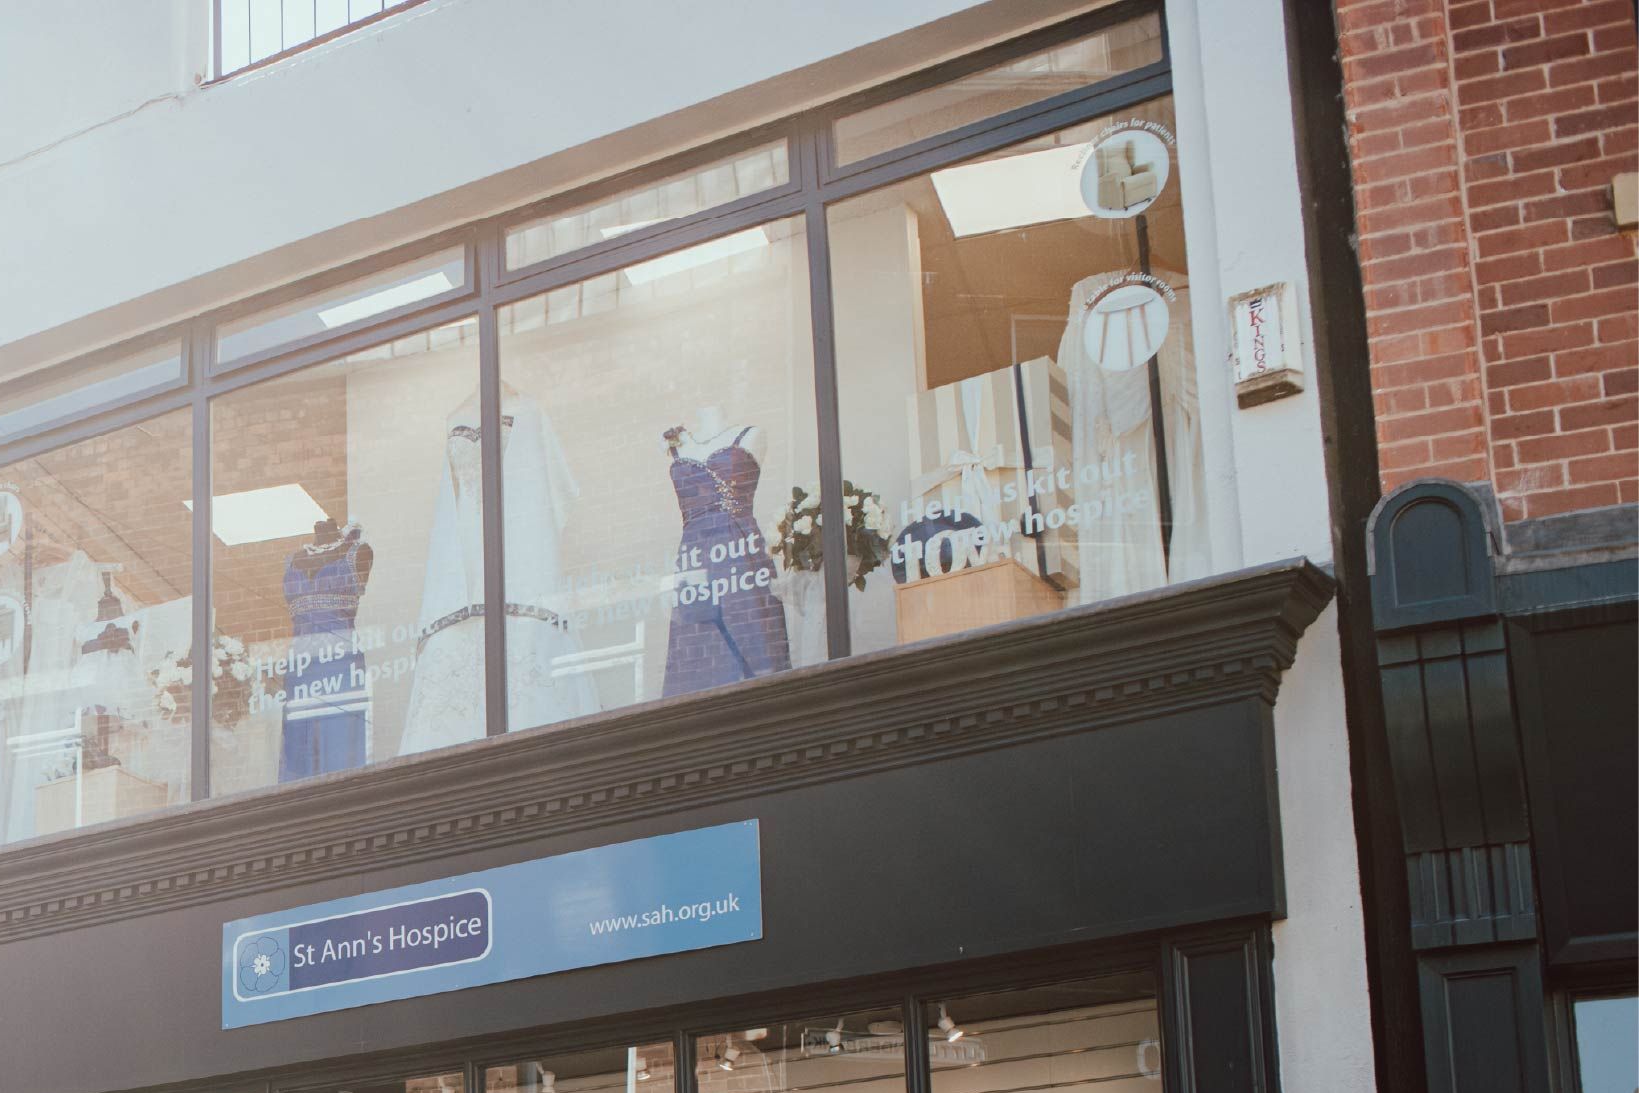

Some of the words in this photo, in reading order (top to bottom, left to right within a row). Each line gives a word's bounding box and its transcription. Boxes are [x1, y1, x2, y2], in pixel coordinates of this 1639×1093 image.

[1130, 117, 1145, 128] for
[1026, 465, 1071, 498] kit
[1079, 447, 1137, 486] out
[710, 531, 760, 564] out
[256, 648, 311, 681] Help
[318, 641, 345, 664] us
[248, 685, 287, 715] the
[294, 672, 343, 701] new
[589, 892, 740, 936] www.sah.org.uk
[294, 943, 316, 968] St
[321, 930, 383, 964] Ann's
[389, 915, 482, 951] Hospice
